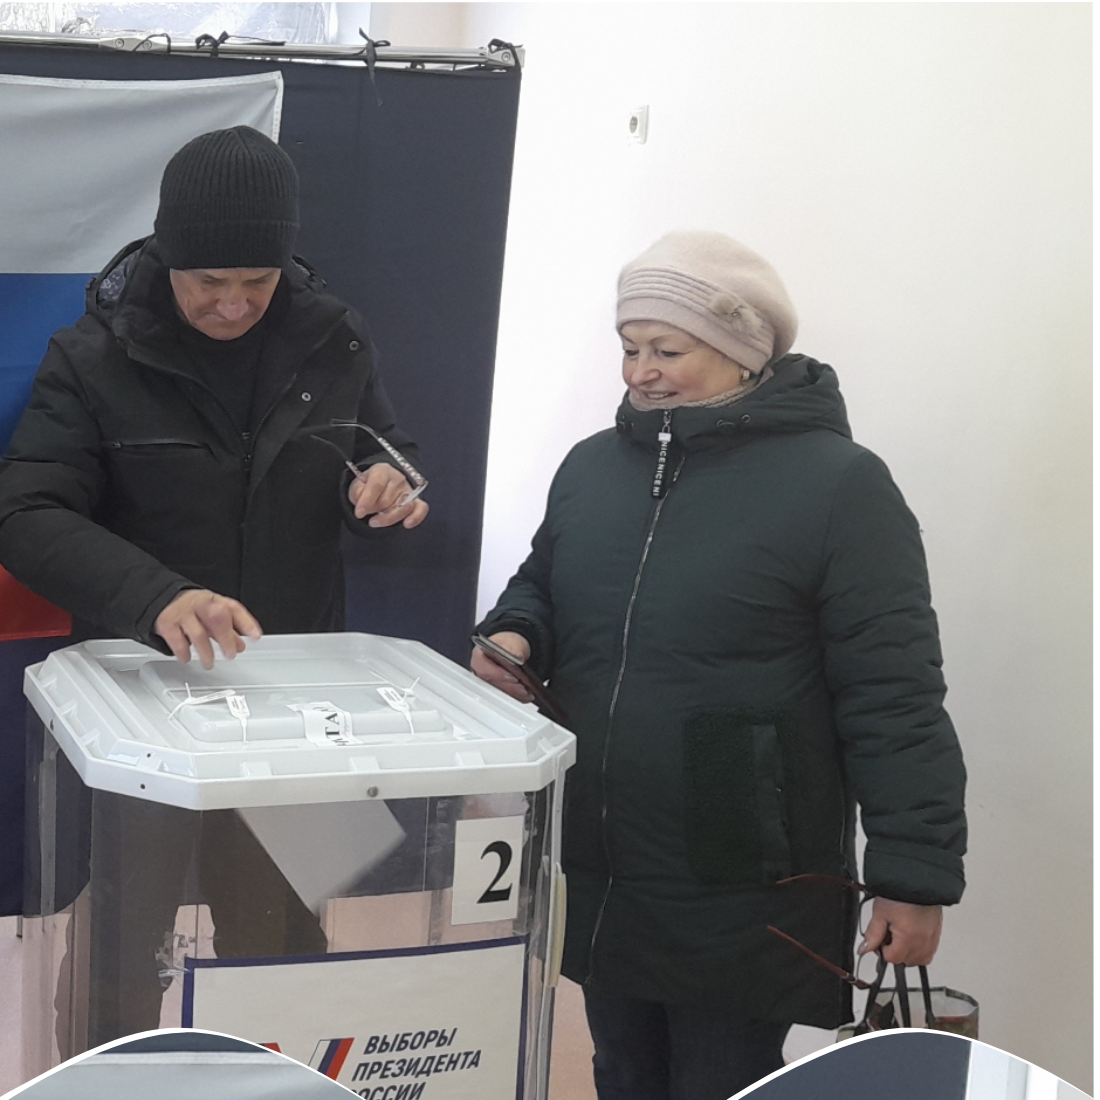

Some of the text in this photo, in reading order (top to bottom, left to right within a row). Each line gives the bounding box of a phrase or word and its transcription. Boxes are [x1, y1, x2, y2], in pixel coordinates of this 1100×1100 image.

[475, 840, 514, 904] 2
[363, 1027, 458, 1055] ВЫБОРЫ
[351, 1050, 482, 1082] ПРЕЗИДЕНТА
